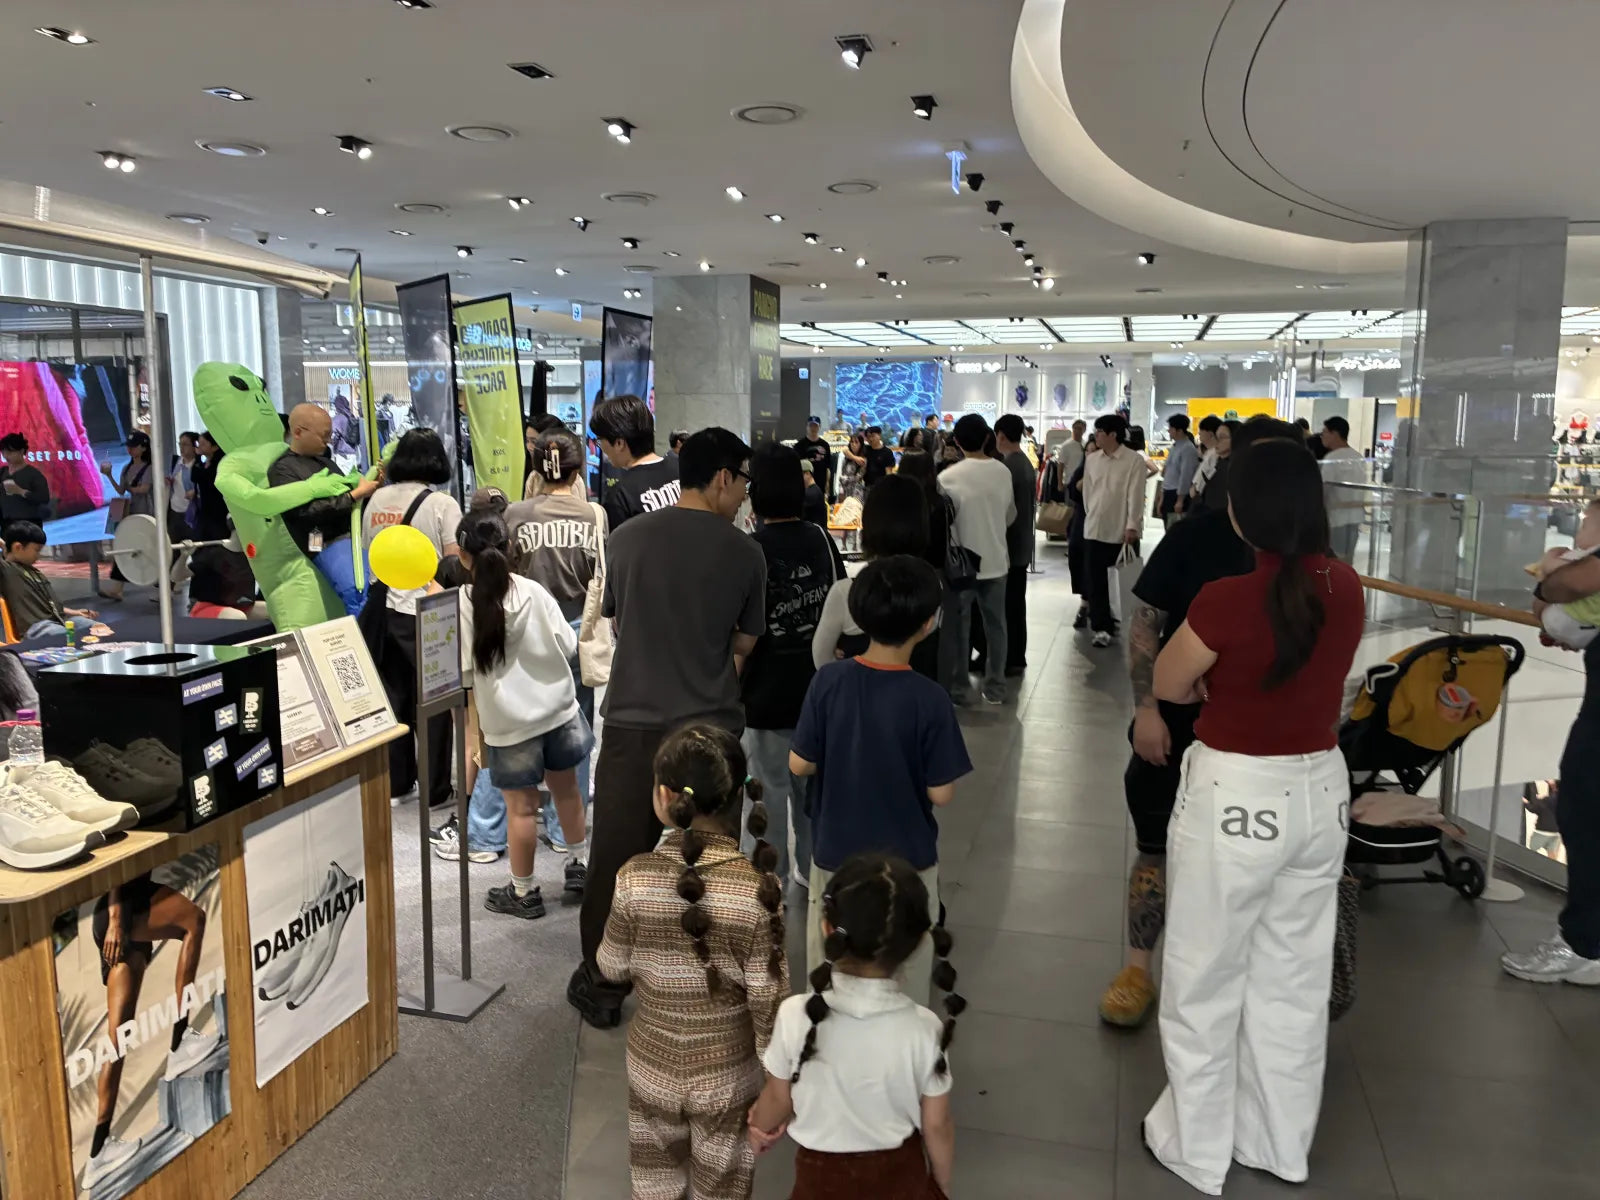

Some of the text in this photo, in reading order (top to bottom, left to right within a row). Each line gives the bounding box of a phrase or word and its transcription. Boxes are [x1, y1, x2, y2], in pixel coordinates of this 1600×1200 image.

[328, 367, 361, 380] WOME
[58, 450, 82, 461] PRO
[371, 511, 412, 529] KODA
[1220, 805, 1280, 841] as
